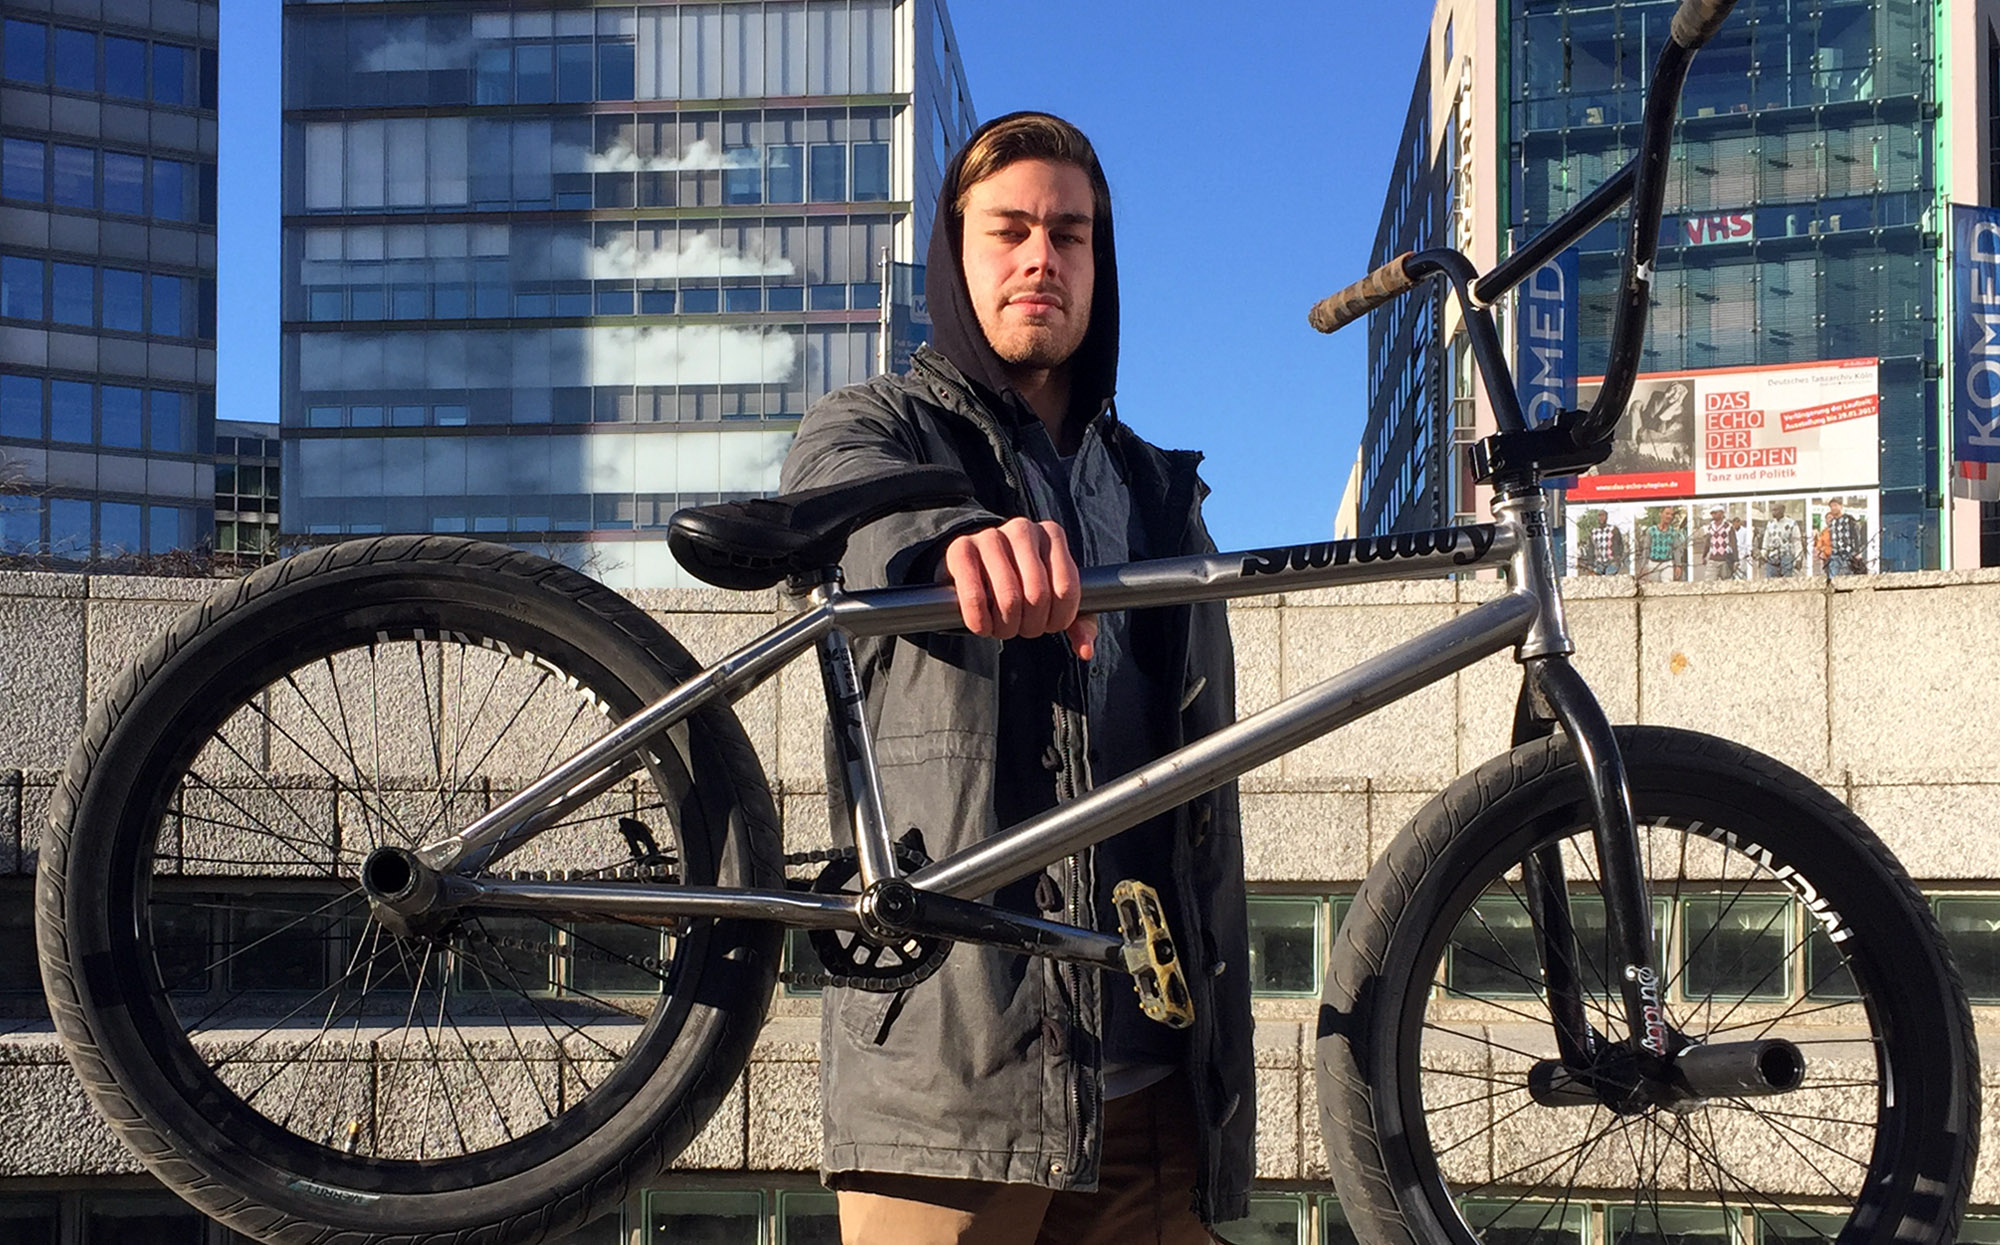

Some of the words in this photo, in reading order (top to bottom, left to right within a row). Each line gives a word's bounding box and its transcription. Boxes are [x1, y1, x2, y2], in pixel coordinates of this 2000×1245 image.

[1686, 215, 1752, 245] VHS
[1528, 259, 1565, 431] OMED
[1767, 376, 1809, 386] Deutsches
[1854, 371, 1873, 380] Köln
[1707, 392, 1748, 411] DAS
[1830, 404, 1843, 412] der
[1708, 411, 1762, 429] ECHO
[1826, 413, 1838, 421] bis
[1708, 432, 1748, 449] DER
[1708, 448, 1795, 469] UTOPIEN
[1706, 472, 1732, 482] Tanz
[1735, 470, 1757, 480] und
[1760, 468, 1797, 479] Politik
[1625, 965, 1667, 1057] Sunday
